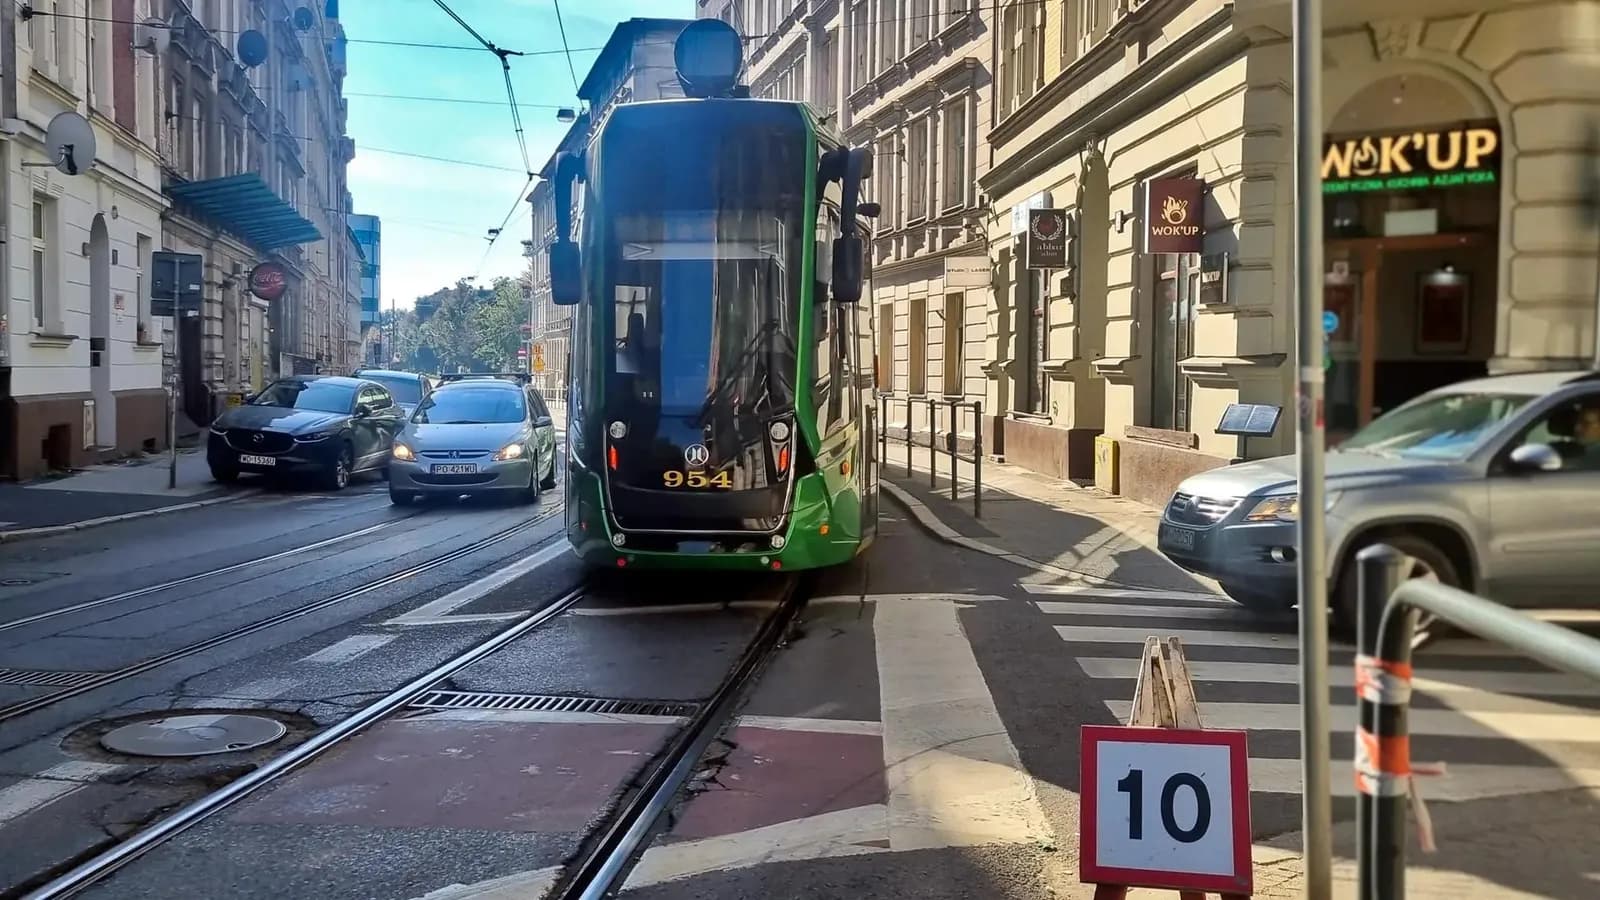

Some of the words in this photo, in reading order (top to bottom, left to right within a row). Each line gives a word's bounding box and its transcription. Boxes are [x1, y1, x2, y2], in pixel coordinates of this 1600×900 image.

[1152, 226, 1199, 236] WOK'UP
[663, 470, 733, 488] 954
[1117, 769, 1212, 844] 10
